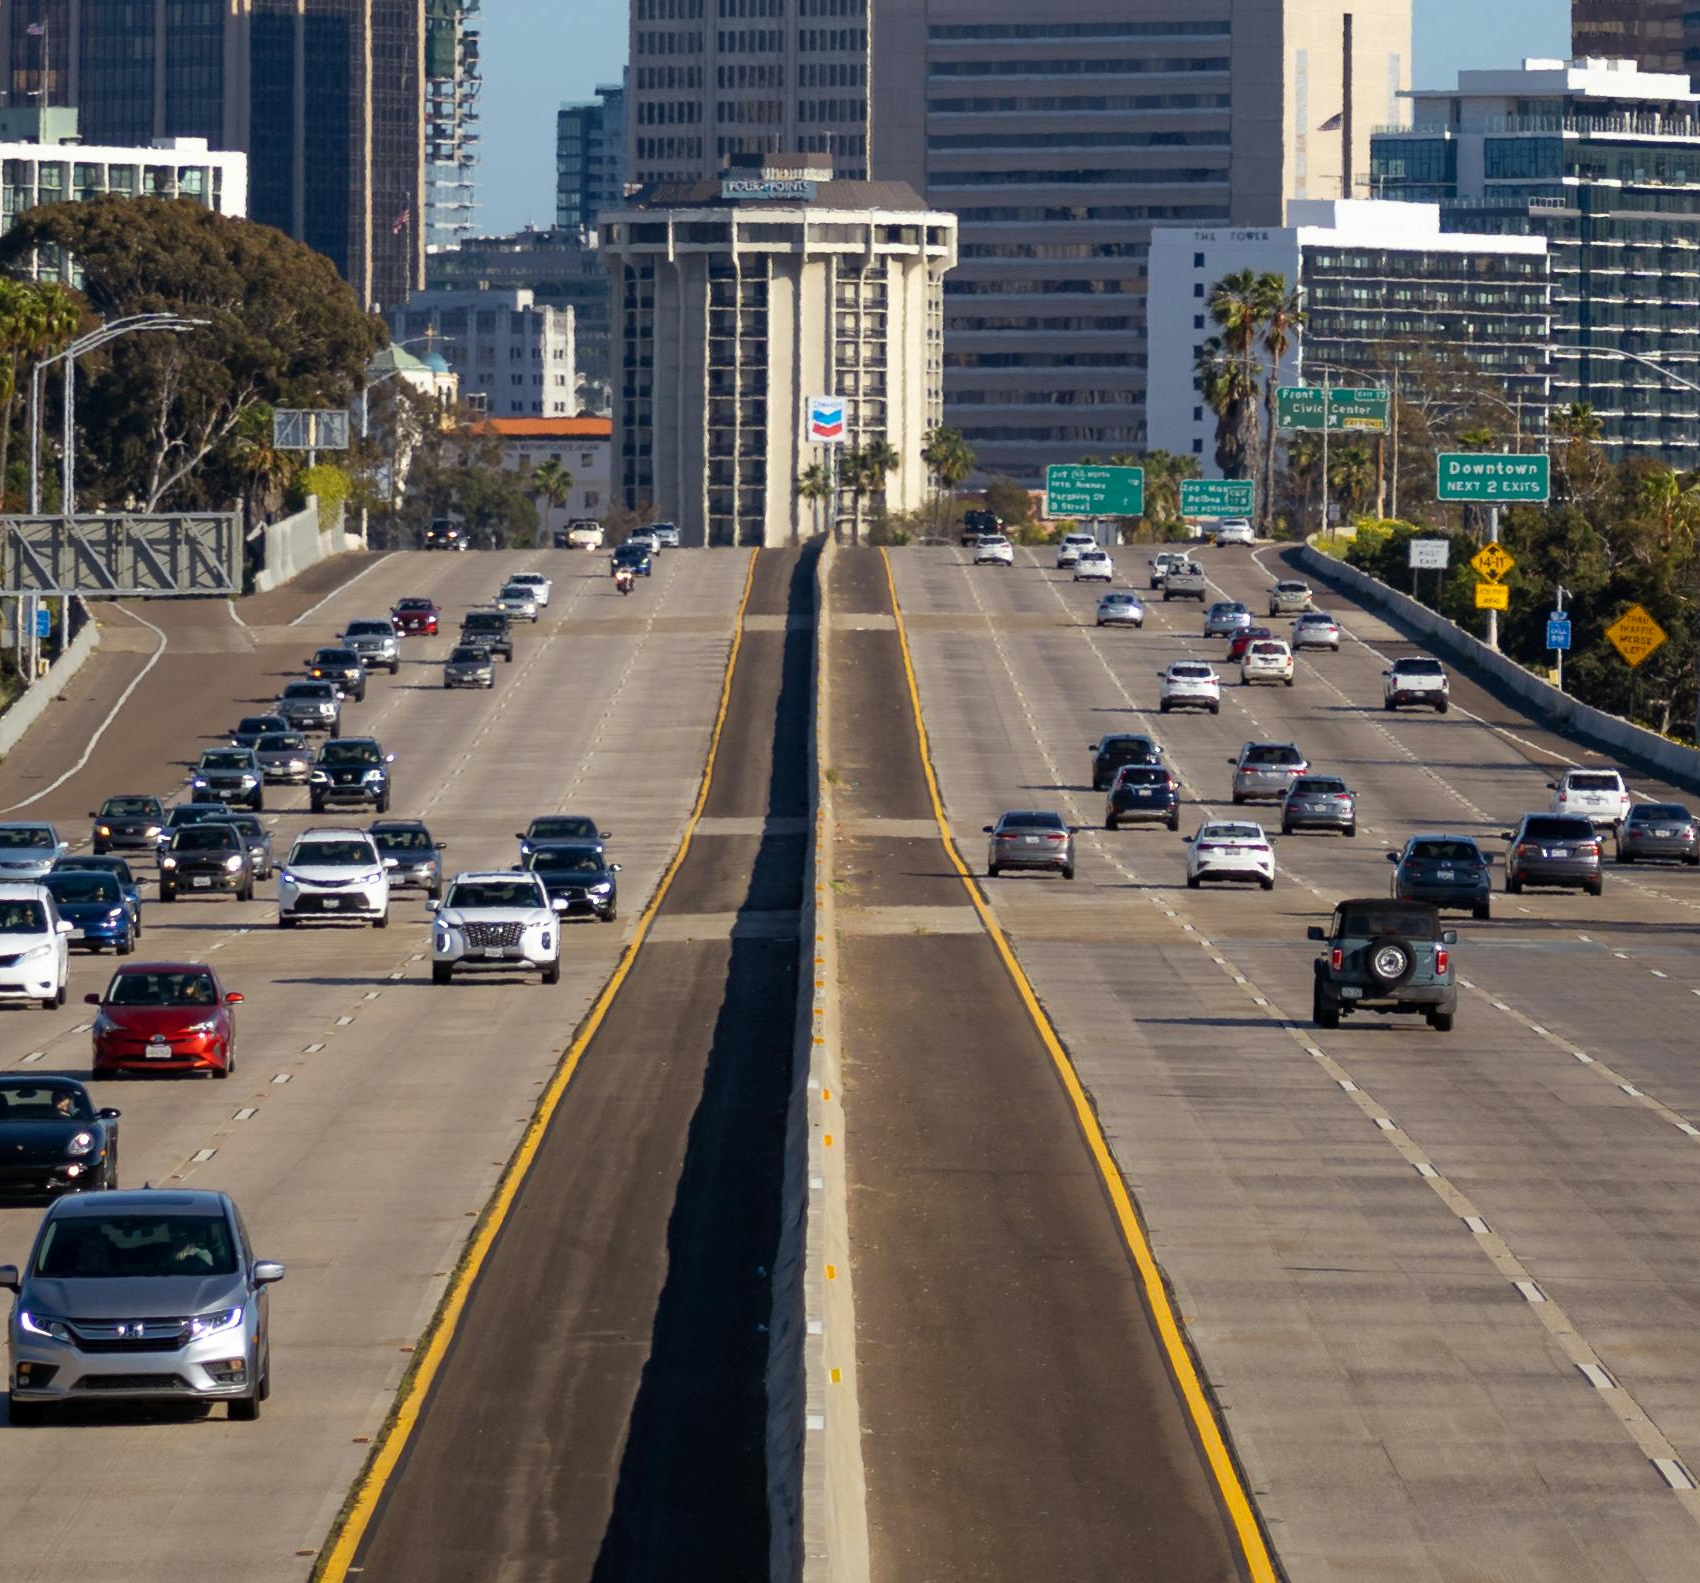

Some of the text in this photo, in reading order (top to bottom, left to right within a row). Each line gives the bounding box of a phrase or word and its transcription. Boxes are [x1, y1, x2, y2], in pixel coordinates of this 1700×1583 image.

[770, 181, 810, 192] POINTS
[1195, 232, 1269, 241] THE TOWER
[1282, 389, 1314, 399] Front
[1292, 403, 1372, 414] Civic Center
[1449, 461, 1538, 475] Downtown
[1447, 481, 1540, 493] NEXT 2 EXITS
[1626, 616, 1649, 624] THRU
[1620, 625, 1654, 634] TRAFFIC
[1620, 635, 1652, 645] MERGE
[1623, 646, 1646, 654] LEFT
